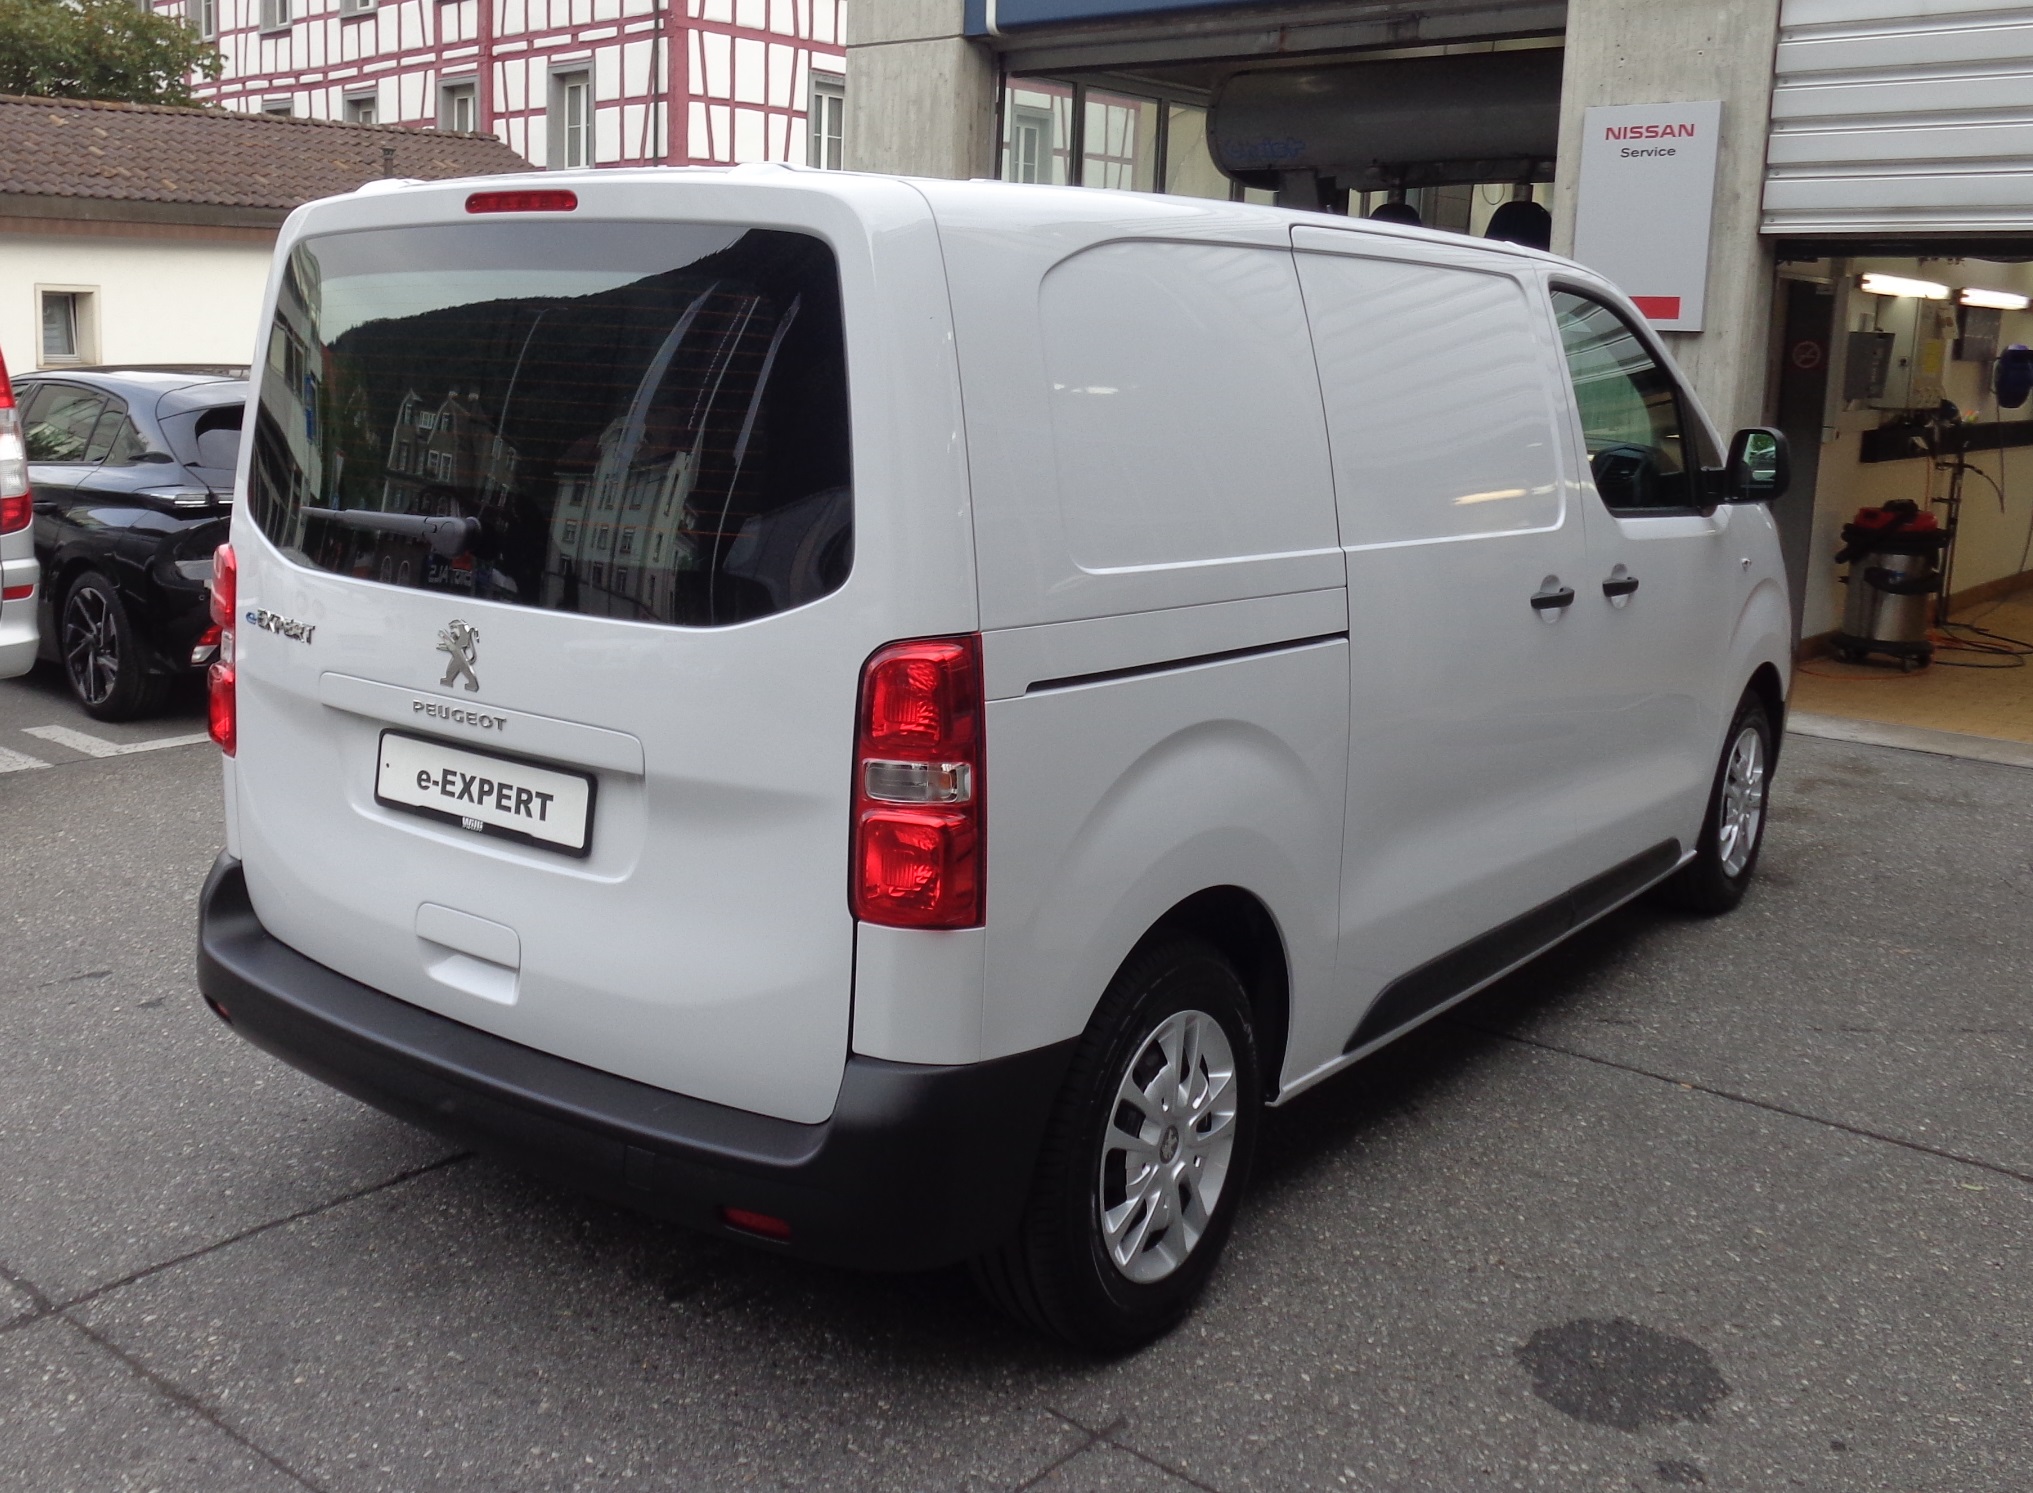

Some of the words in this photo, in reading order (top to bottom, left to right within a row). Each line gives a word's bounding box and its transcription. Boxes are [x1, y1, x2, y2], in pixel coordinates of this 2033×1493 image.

[1605, 124, 1695, 140] NISSAN
[1620, 147, 1677, 158] Service
[413, 700, 507, 731] PEUGEOT
[416, 768, 554, 822] e-EXPERT
